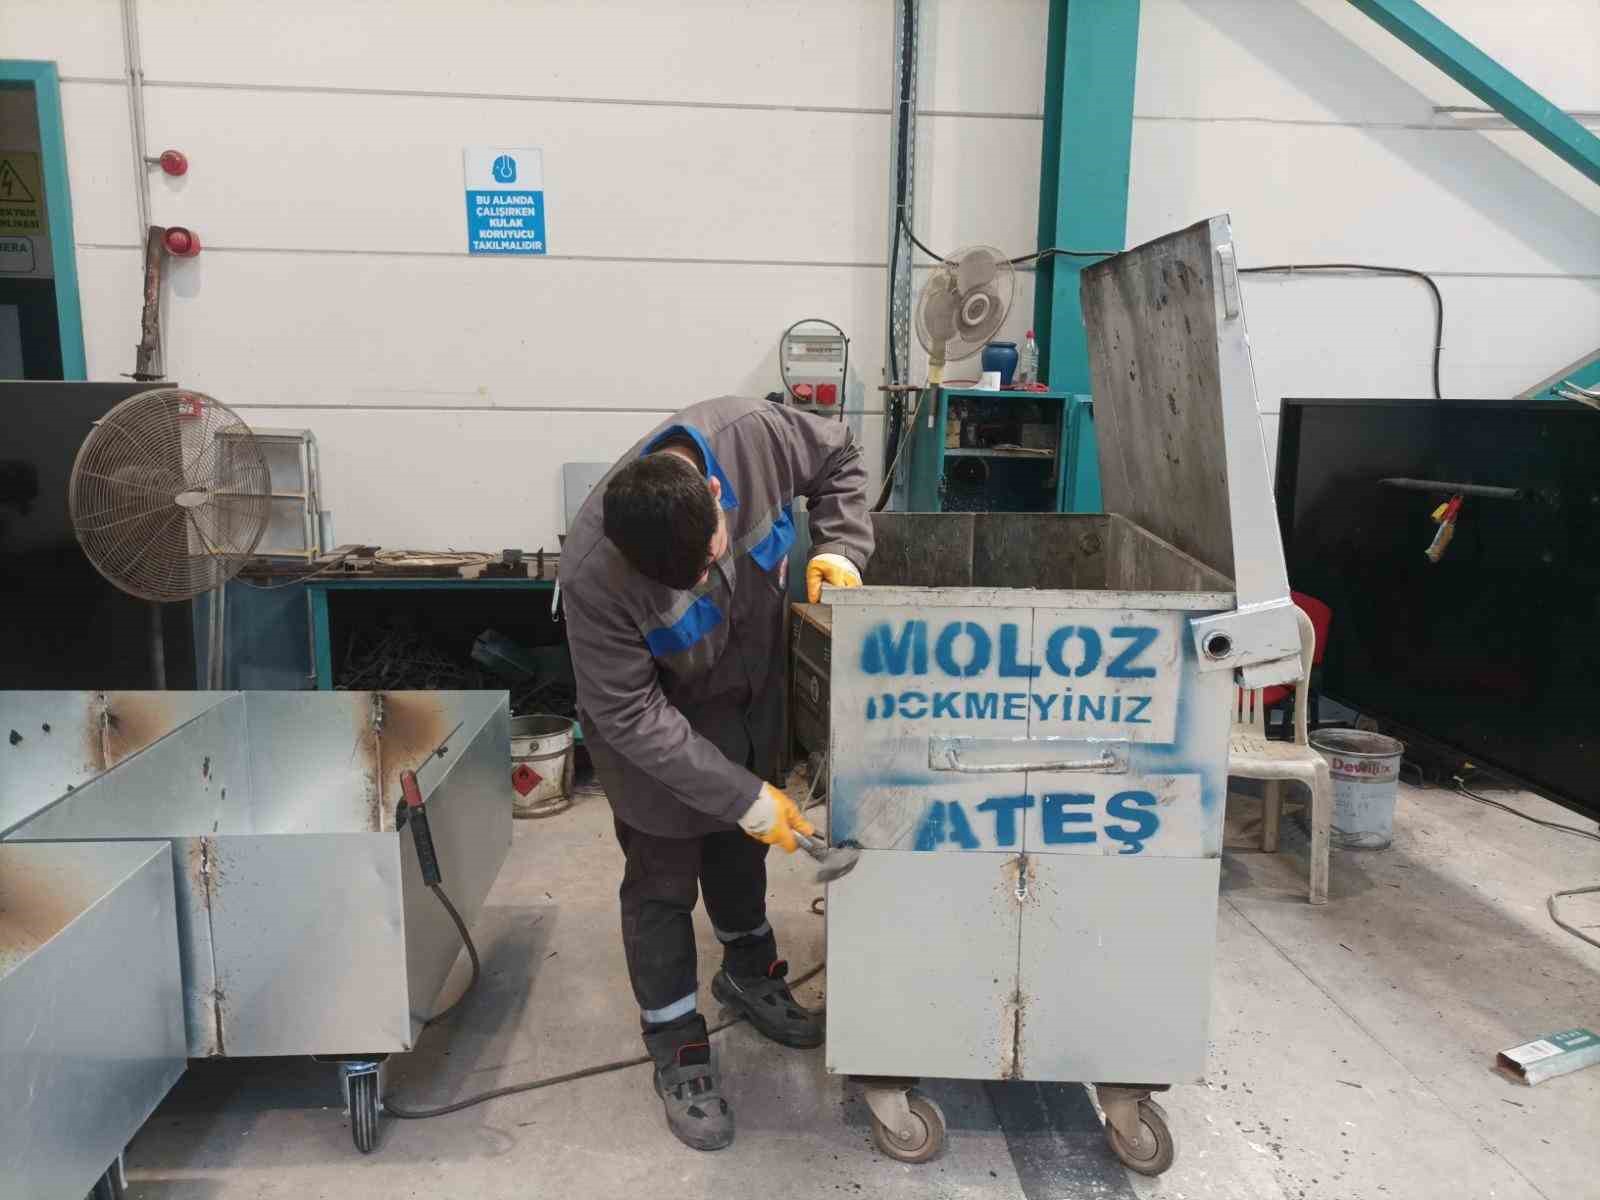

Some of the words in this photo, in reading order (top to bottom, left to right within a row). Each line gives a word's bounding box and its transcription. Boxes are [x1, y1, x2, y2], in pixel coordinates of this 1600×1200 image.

[476, 196, 490, 205] BU
[492, 196, 534, 205] ALANDA
[476, 207, 535, 217] ÇALIŞIRKEN
[489, 218, 524, 227] KULAK
[479, 229, 535, 239] KORUYUCU
[473, 240, 542, 250] TAKILMALIDIR
[860, 620, 1160, 678] MOLOZ
[912, 790, 1160, 855] ATEŞ
